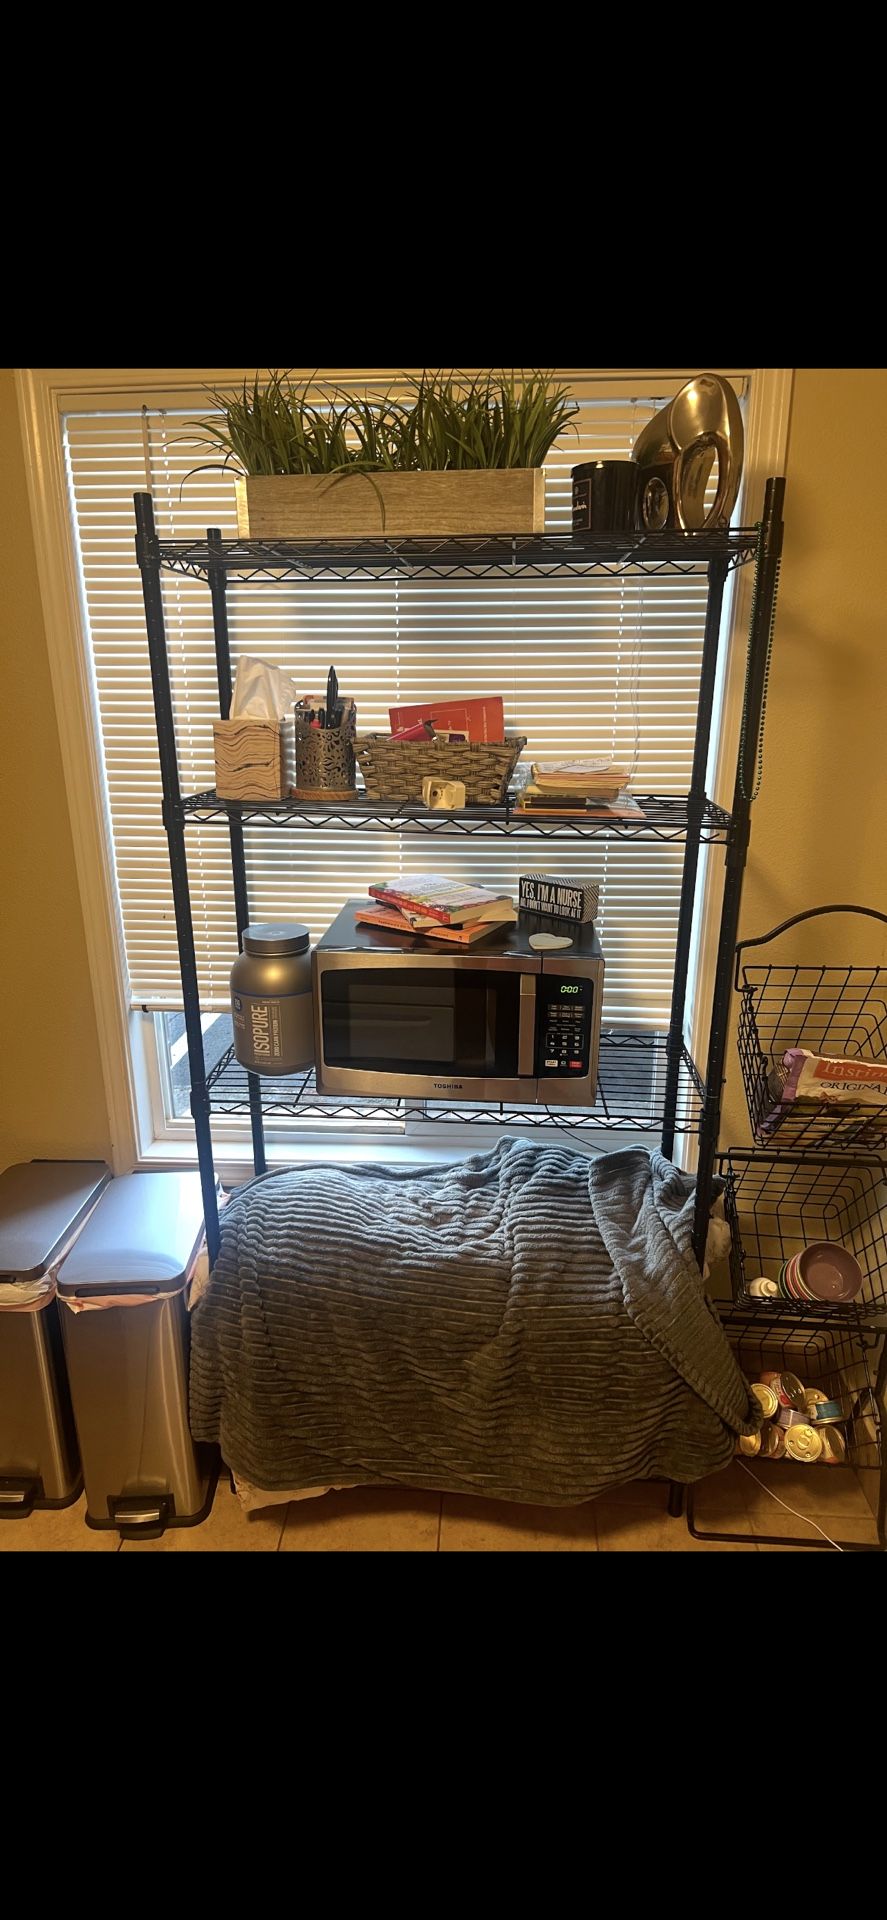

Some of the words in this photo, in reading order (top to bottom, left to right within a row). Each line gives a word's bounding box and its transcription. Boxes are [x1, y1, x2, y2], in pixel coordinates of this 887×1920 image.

[521, 881, 536, 900] YES,
[537, 884, 549, 902] I'M
[550, 886, 556, 904] A
[557, 888, 582, 908] NURSE
[541, 902, 553, 913] WANT
[560, 906, 571, 917] LOOK
[571, 908, 576, 918] AT
[577, 909, 582, 919] IT
[251, 1005, 271, 1056] ISOPURE
